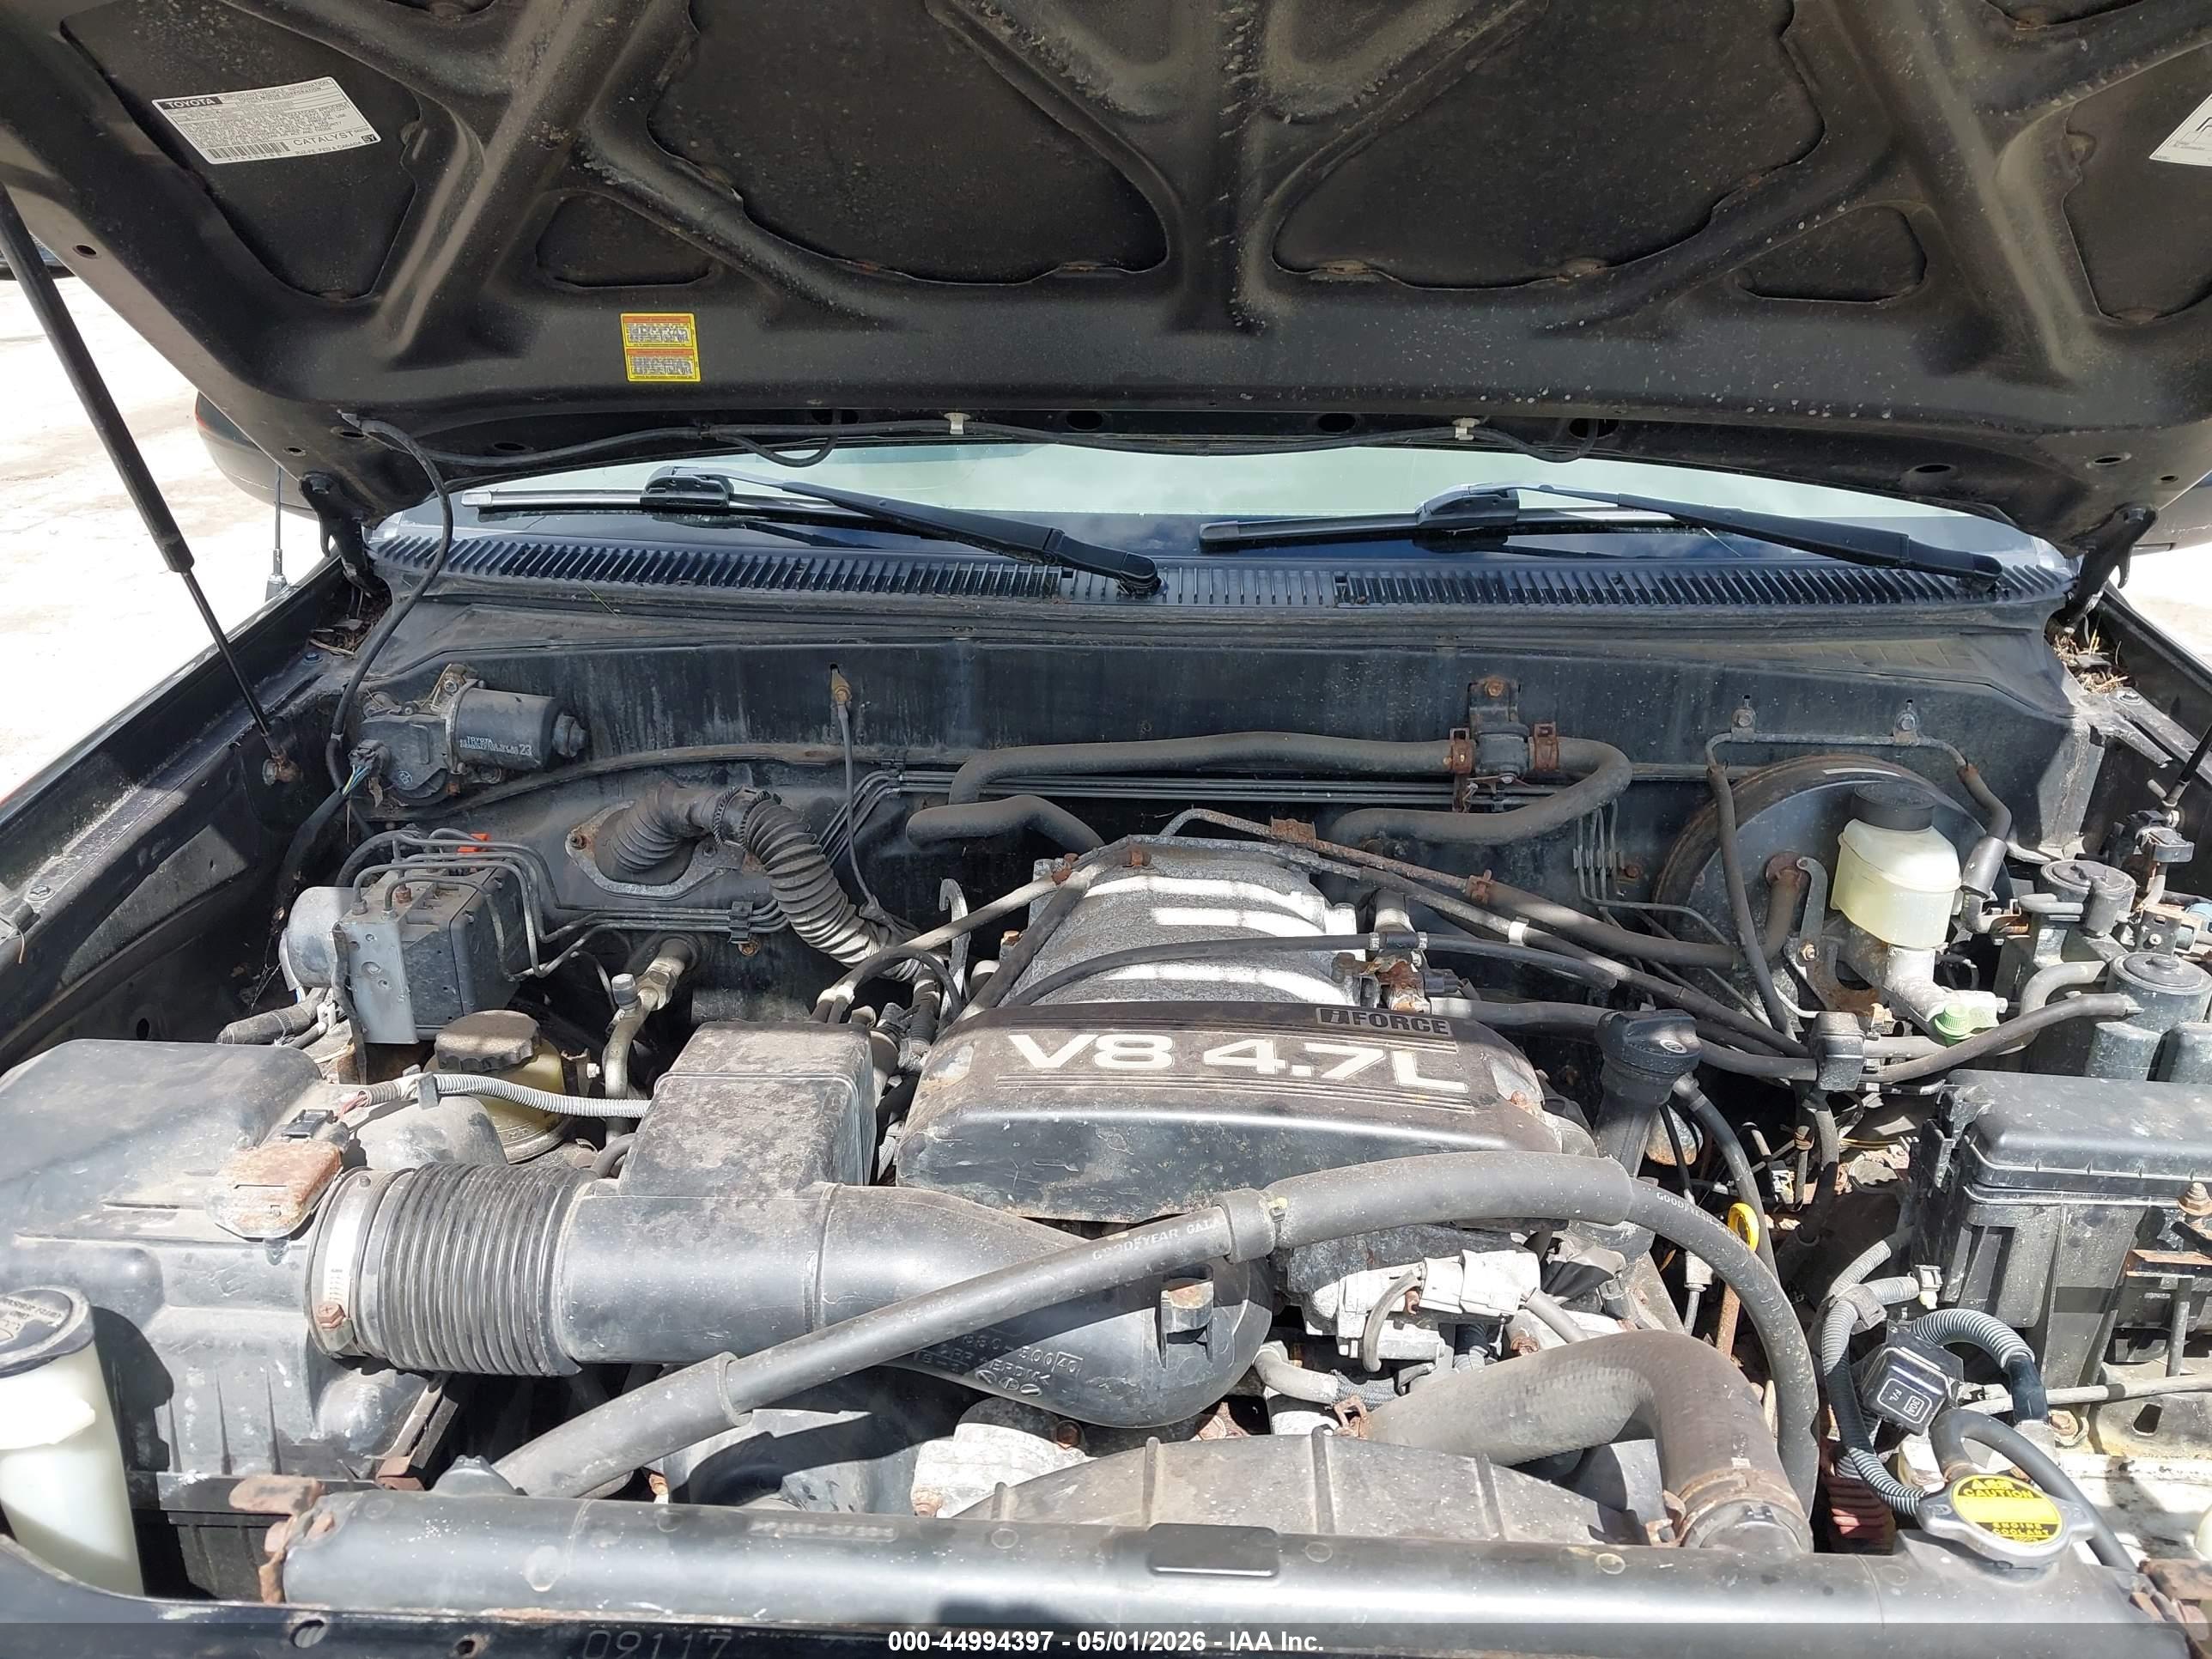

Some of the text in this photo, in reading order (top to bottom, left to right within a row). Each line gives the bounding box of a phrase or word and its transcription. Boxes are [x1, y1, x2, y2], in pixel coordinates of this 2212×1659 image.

[167, 98, 216, 108] TOYOTA
[294, 131, 355, 147] CATALYST
[1008, 1034, 1469, 1094] V8 4.7L
[1964, 1488, 2033, 1498] CAUTION
